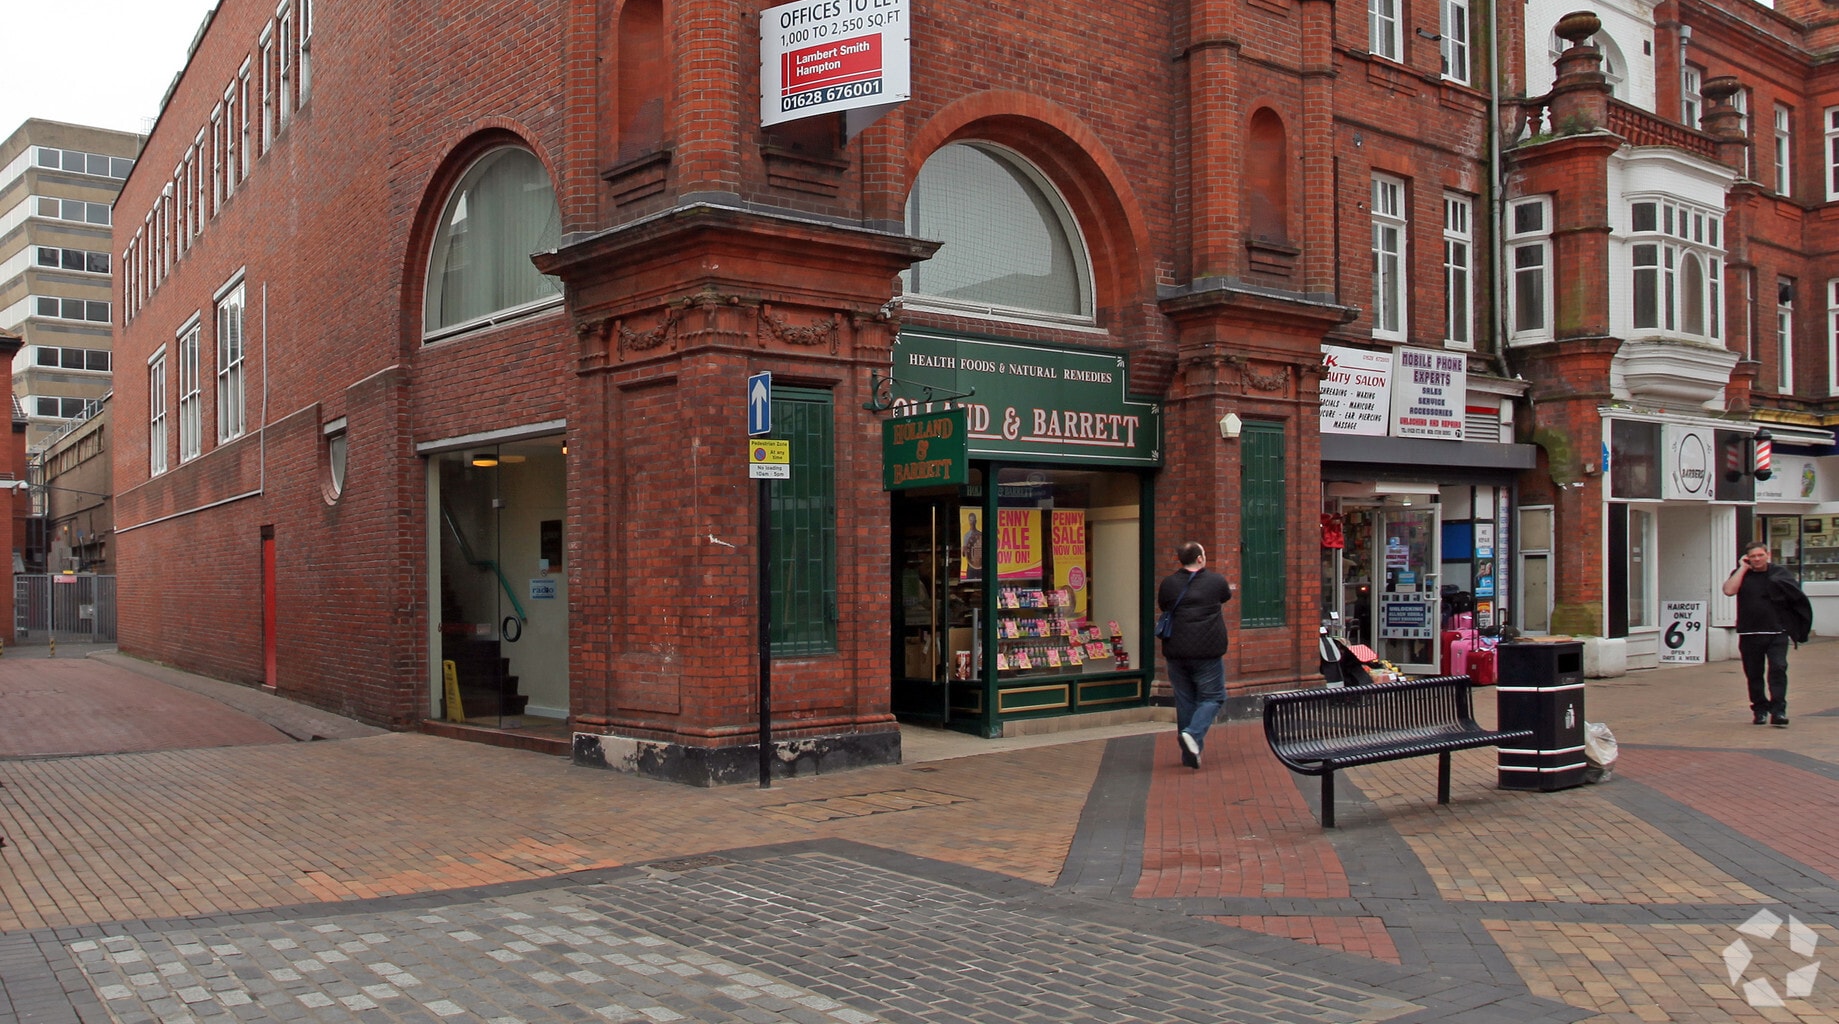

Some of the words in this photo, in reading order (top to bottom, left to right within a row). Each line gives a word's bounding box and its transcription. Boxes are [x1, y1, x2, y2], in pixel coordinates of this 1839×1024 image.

[780, 0, 840, 28] OFFICES
[780, 29, 809, 47] 1,000
[813, 25, 828, 38] TO
[832, 17, 863, 35] 2,550
[868, 10, 900, 27] SQ.FT
[796, 47, 838, 64] Lambert
[840, 41, 870, 56] Smith
[796, 60, 840, 76] Hampton
[783, 91, 822, 110] 01628
[826, 80, 880, 101] 676001
[909, 354, 956, 368] HEALTH
[960, 358, 996, 373] FOODS
[999, 362, 1006, 374] &
[1009, 364, 1056, 378] NATURAL
[1064, 369, 1112, 384] REMEDIES
[1402, 352, 1432, 369] MOBILE
[1436, 356, 1462, 372] PHONE
[1355, 375, 1386, 388] SALON
[1414, 369, 1450, 386] EXPERTS
[1349, 402, 1374, 410] MANICURE
[1418, 398, 1445, 406] SERVICE
[1358, 413, 1382, 422] PIERCING
[1410, 407, 1452, 416] ACCESSORIES
[893, 418, 954, 445] HOLLAND
[1003, 406, 1020, 440] &
[1033, 408, 1139, 448] BARRETT
[1333, 421, 1358, 430] MASSAGE
[916, 440, 929, 460] &
[893, 458, 952, 484] BARRETT
[999, 510, 1030, 526] ENNY
[1053, 512, 1084, 526] PENNY
[1053, 526, 1084, 544] SALE
[998, 551, 1012, 564] OW
[1016, 551, 1030, 564] ON!
[1054, 545, 1070, 556] NOW
[1072, 545, 1084, 556] ON!
